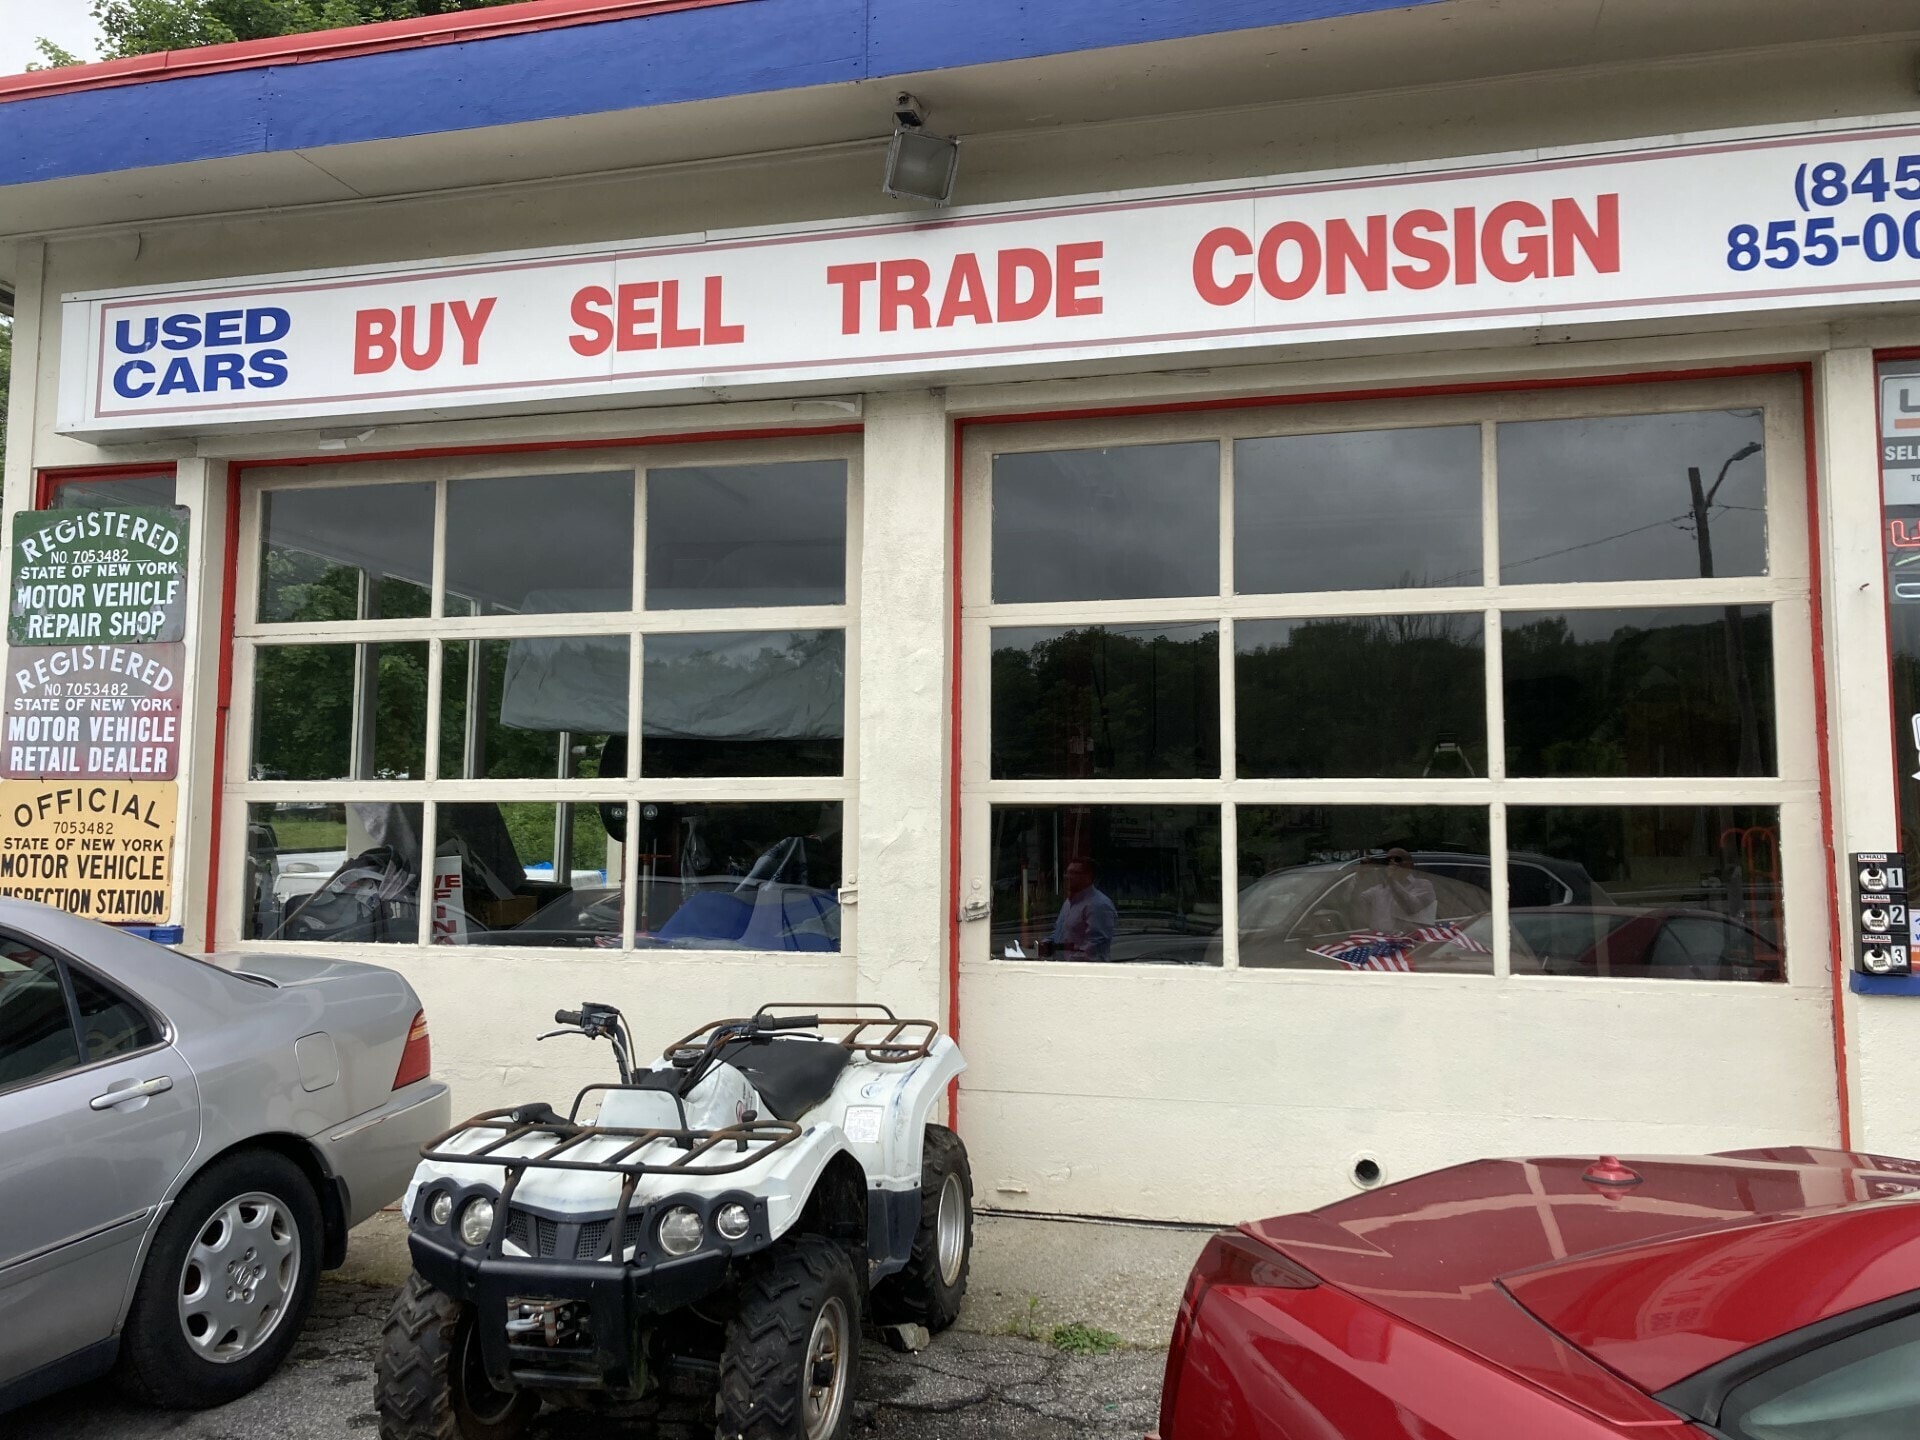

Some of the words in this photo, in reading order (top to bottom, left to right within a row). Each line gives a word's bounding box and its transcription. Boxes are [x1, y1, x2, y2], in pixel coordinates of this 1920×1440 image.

[1794, 154, 1920, 212] (845
[353, 296, 498, 376] BUY
[568, 275, 745, 357] SELL
[826, 240, 1104, 336] TRADE
[1192, 192, 1620, 306] CONSIGN
[115, 306, 291, 355] USED
[113, 348, 288, 398] CARS
[1884, 444, 1920, 461] SEL
[21, 511, 179, 563] REGISTERED
[51, 551, 69, 564] NO.
[73, 549, 129, 563] 7053482
[20, 565, 66, 580] STATE
[72, 565, 92, 578] OF
[97, 564, 131, 577] NEW
[137, 561, 178, 576] YORK
[17, 582, 86, 609] MOTOR
[92, 580, 179, 607] VEHICLE
[28, 612, 102, 639] REPAIR
[109, 610, 166, 636] SHOP
[15, 645, 173, 694] REGISTERED
[44, 683, 63, 697] NO.
[66, 683, 129, 696] 7053482
[14, 698, 60, 711] STATE
[65, 698, 86, 711] OF
[91, 699, 125, 711] NEW
[131, 698, 173, 711] YORK
[8, 716, 80, 742] MOTOR
[89, 716, 176, 743] VEHICLE
[10, 746, 80, 772] RETAIL
[88, 747, 168, 773] DEALER
[14, 787, 160, 829] OFFICIAL
[53, 822, 114, 835] 7053482
[4, 837, 49, 850] STATE
[55, 838, 76, 850] OF
[81, 838, 115, 851] NEW
[122, 839, 164, 851] YORK
[0, 853, 69, 879] MOTOR
[77, 854, 165, 880] VEHICLE
[1892, 869, 1899, 886] 1
[95, 889, 164, 915] STATION
[1892, 906, 1903, 923] 2
[1894, 948, 1903, 963] 3
